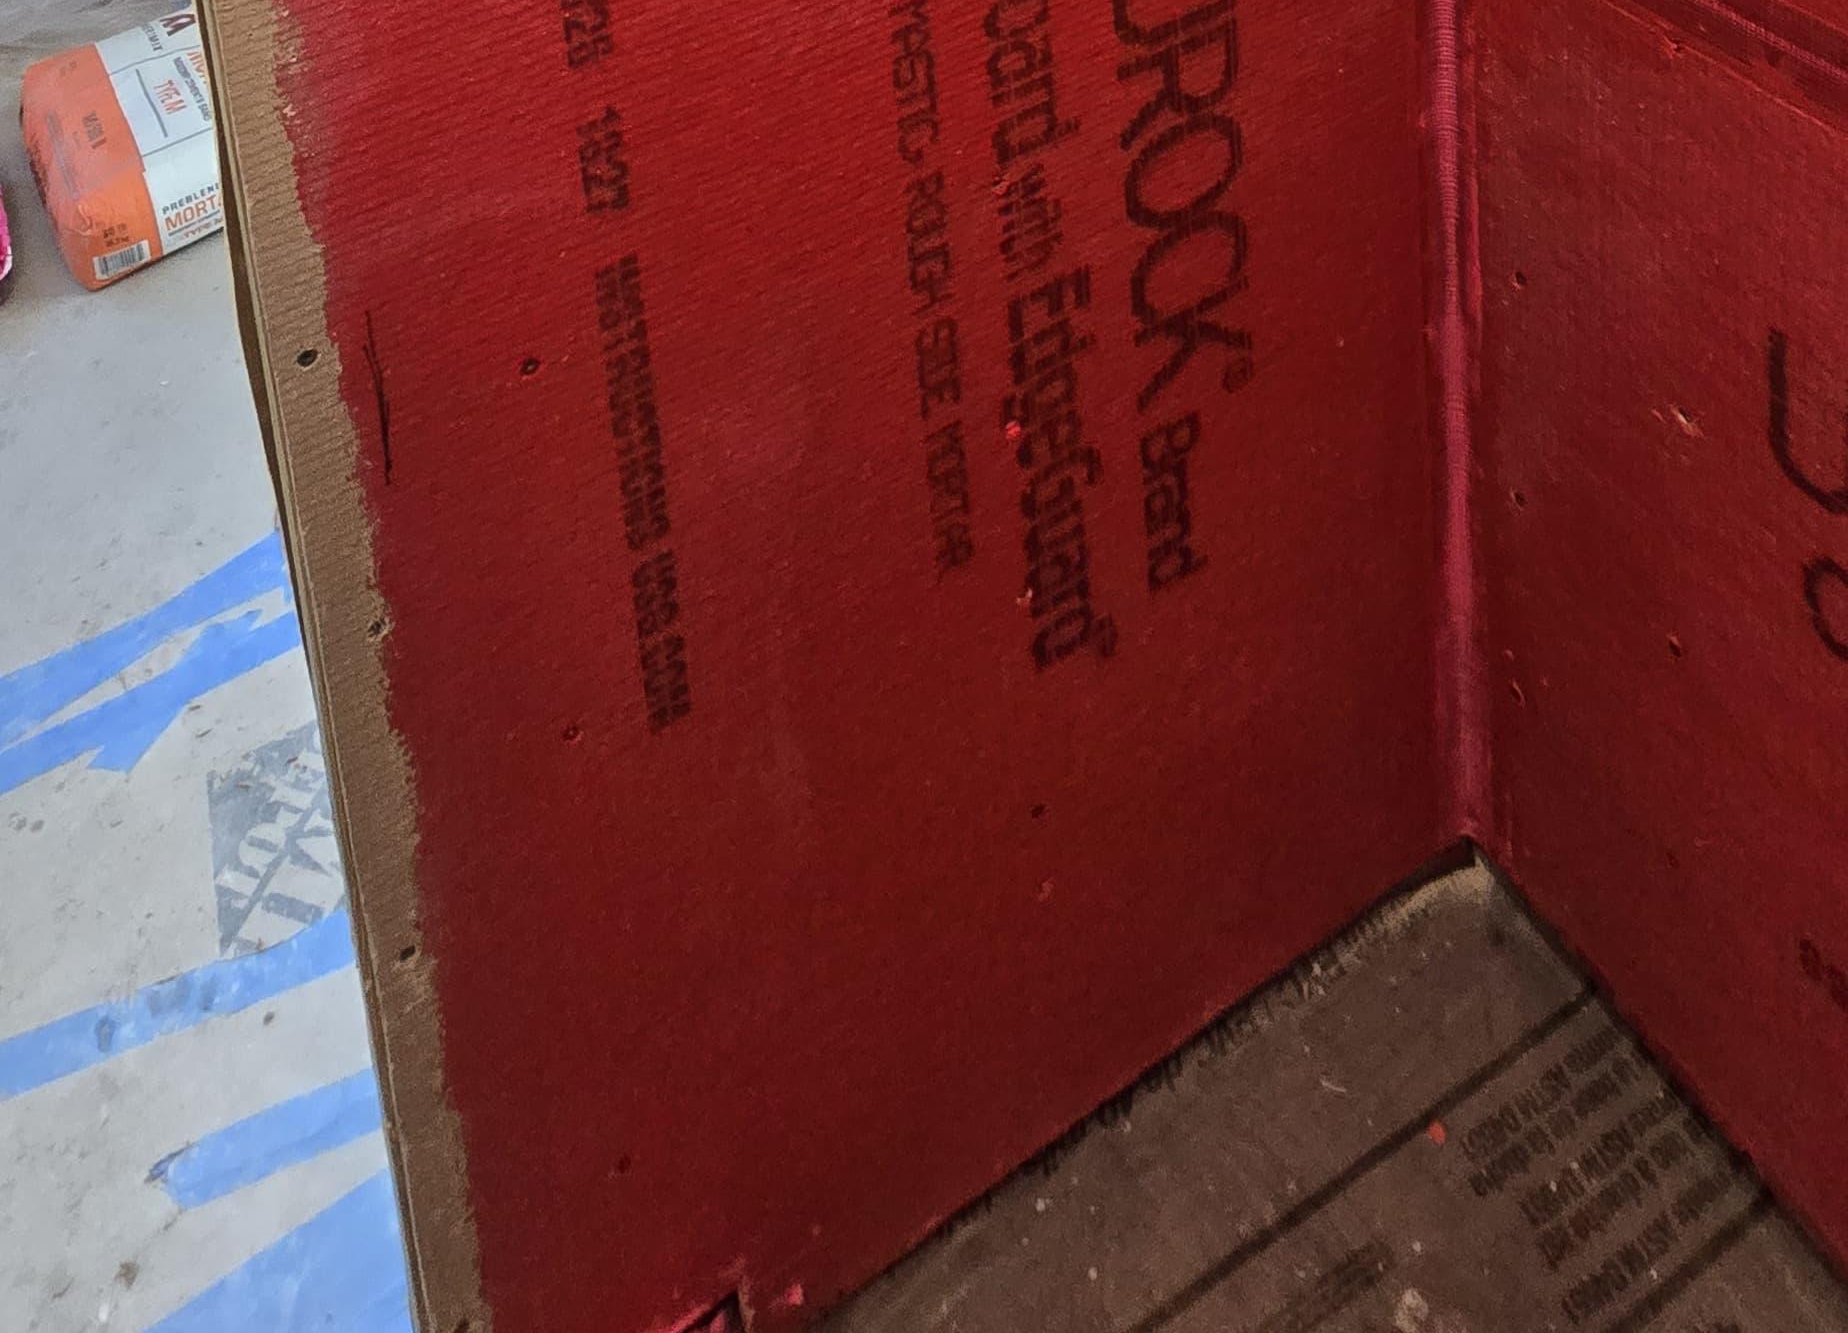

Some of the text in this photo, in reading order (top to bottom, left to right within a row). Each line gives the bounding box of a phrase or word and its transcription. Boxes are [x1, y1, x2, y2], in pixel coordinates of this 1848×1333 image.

[904, 169, 957, 317] ROUGH
[1000, 163, 1062, 283] with
[915, 316, 963, 422] SIDE
[925, 420, 976, 591] MORTAR
[1138, 411, 1209, 597] Brand
